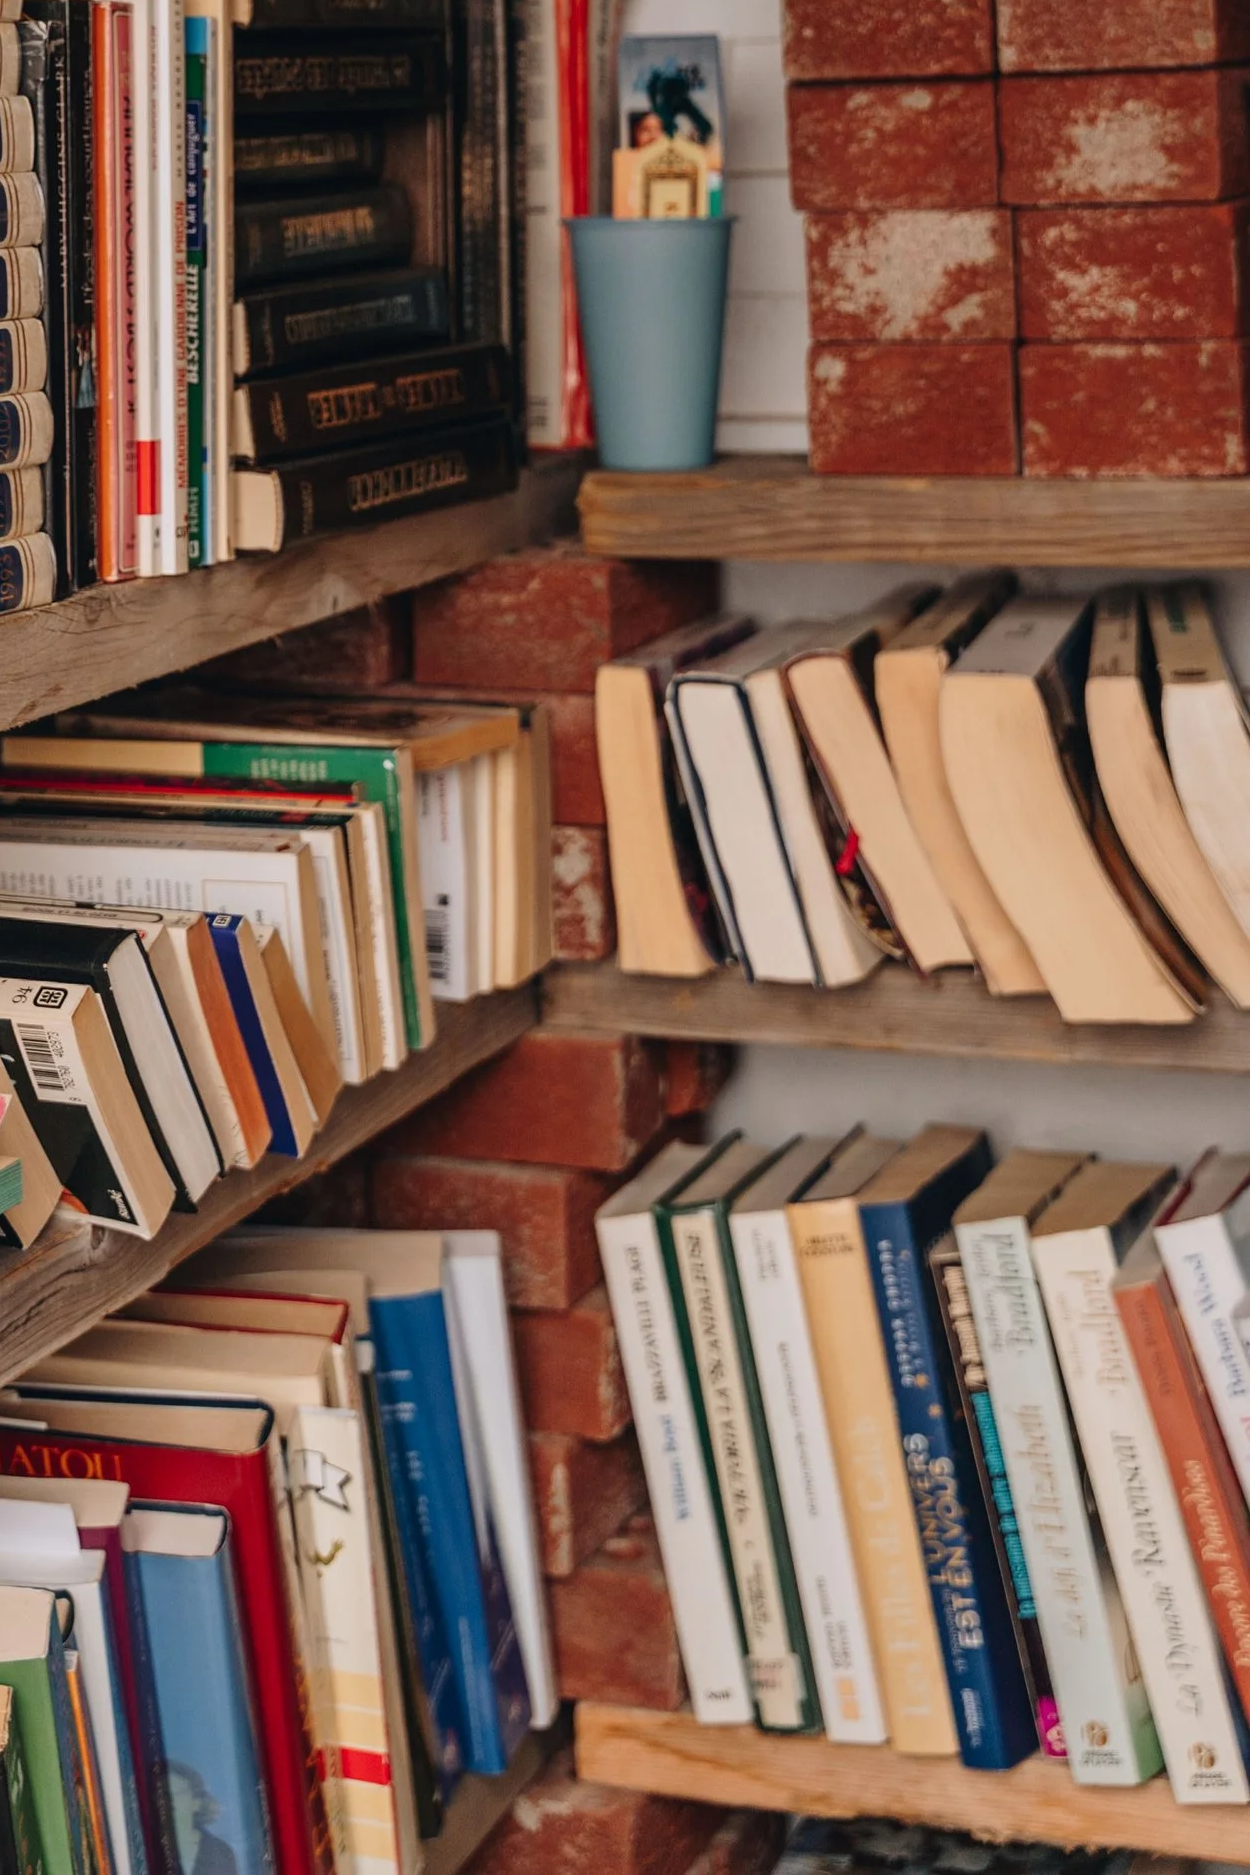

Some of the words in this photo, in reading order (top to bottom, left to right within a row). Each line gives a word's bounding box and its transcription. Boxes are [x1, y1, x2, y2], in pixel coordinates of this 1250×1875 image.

[54, 55, 66, 122] CLARK
[56, 132, 67, 222] HIGGINS
[187, 182, 197, 197] de
[174, 201, 185, 254] PRISON
[186, 264, 200, 383] BESCHERELLE
[12, 986, 32, 1004] 94
[983, 1232, 1036, 1352] Bradford
[903, 1432, 951, 1584] L'UNIVERS
[933, 1455, 967, 1541] VOUS
[944, 1545, 974, 1585] EN
[950, 1586, 985, 1649] EST
